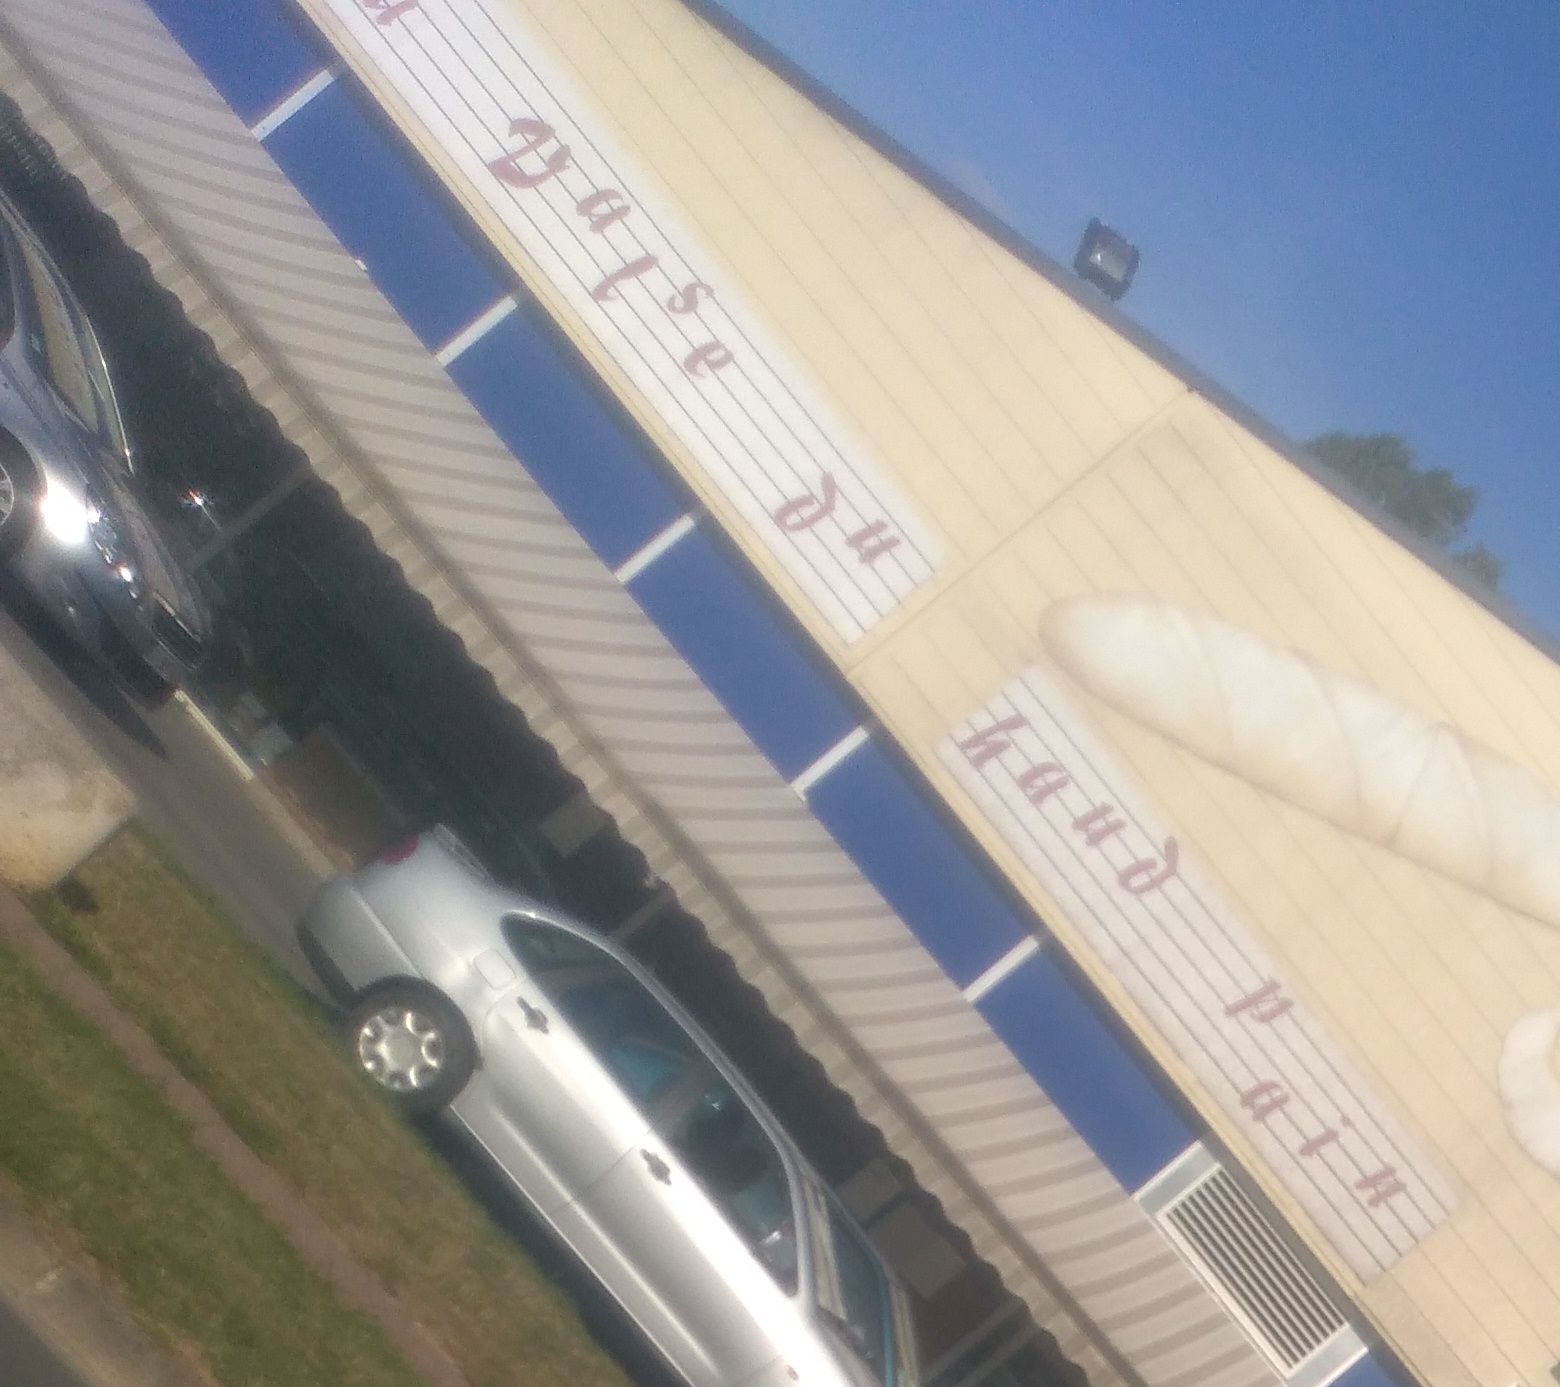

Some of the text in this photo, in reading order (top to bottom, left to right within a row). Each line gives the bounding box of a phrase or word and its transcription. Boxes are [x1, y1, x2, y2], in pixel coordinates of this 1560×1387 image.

[488, 117, 900, 567] Valse du
[1224, 978, 1406, 1208] pain
